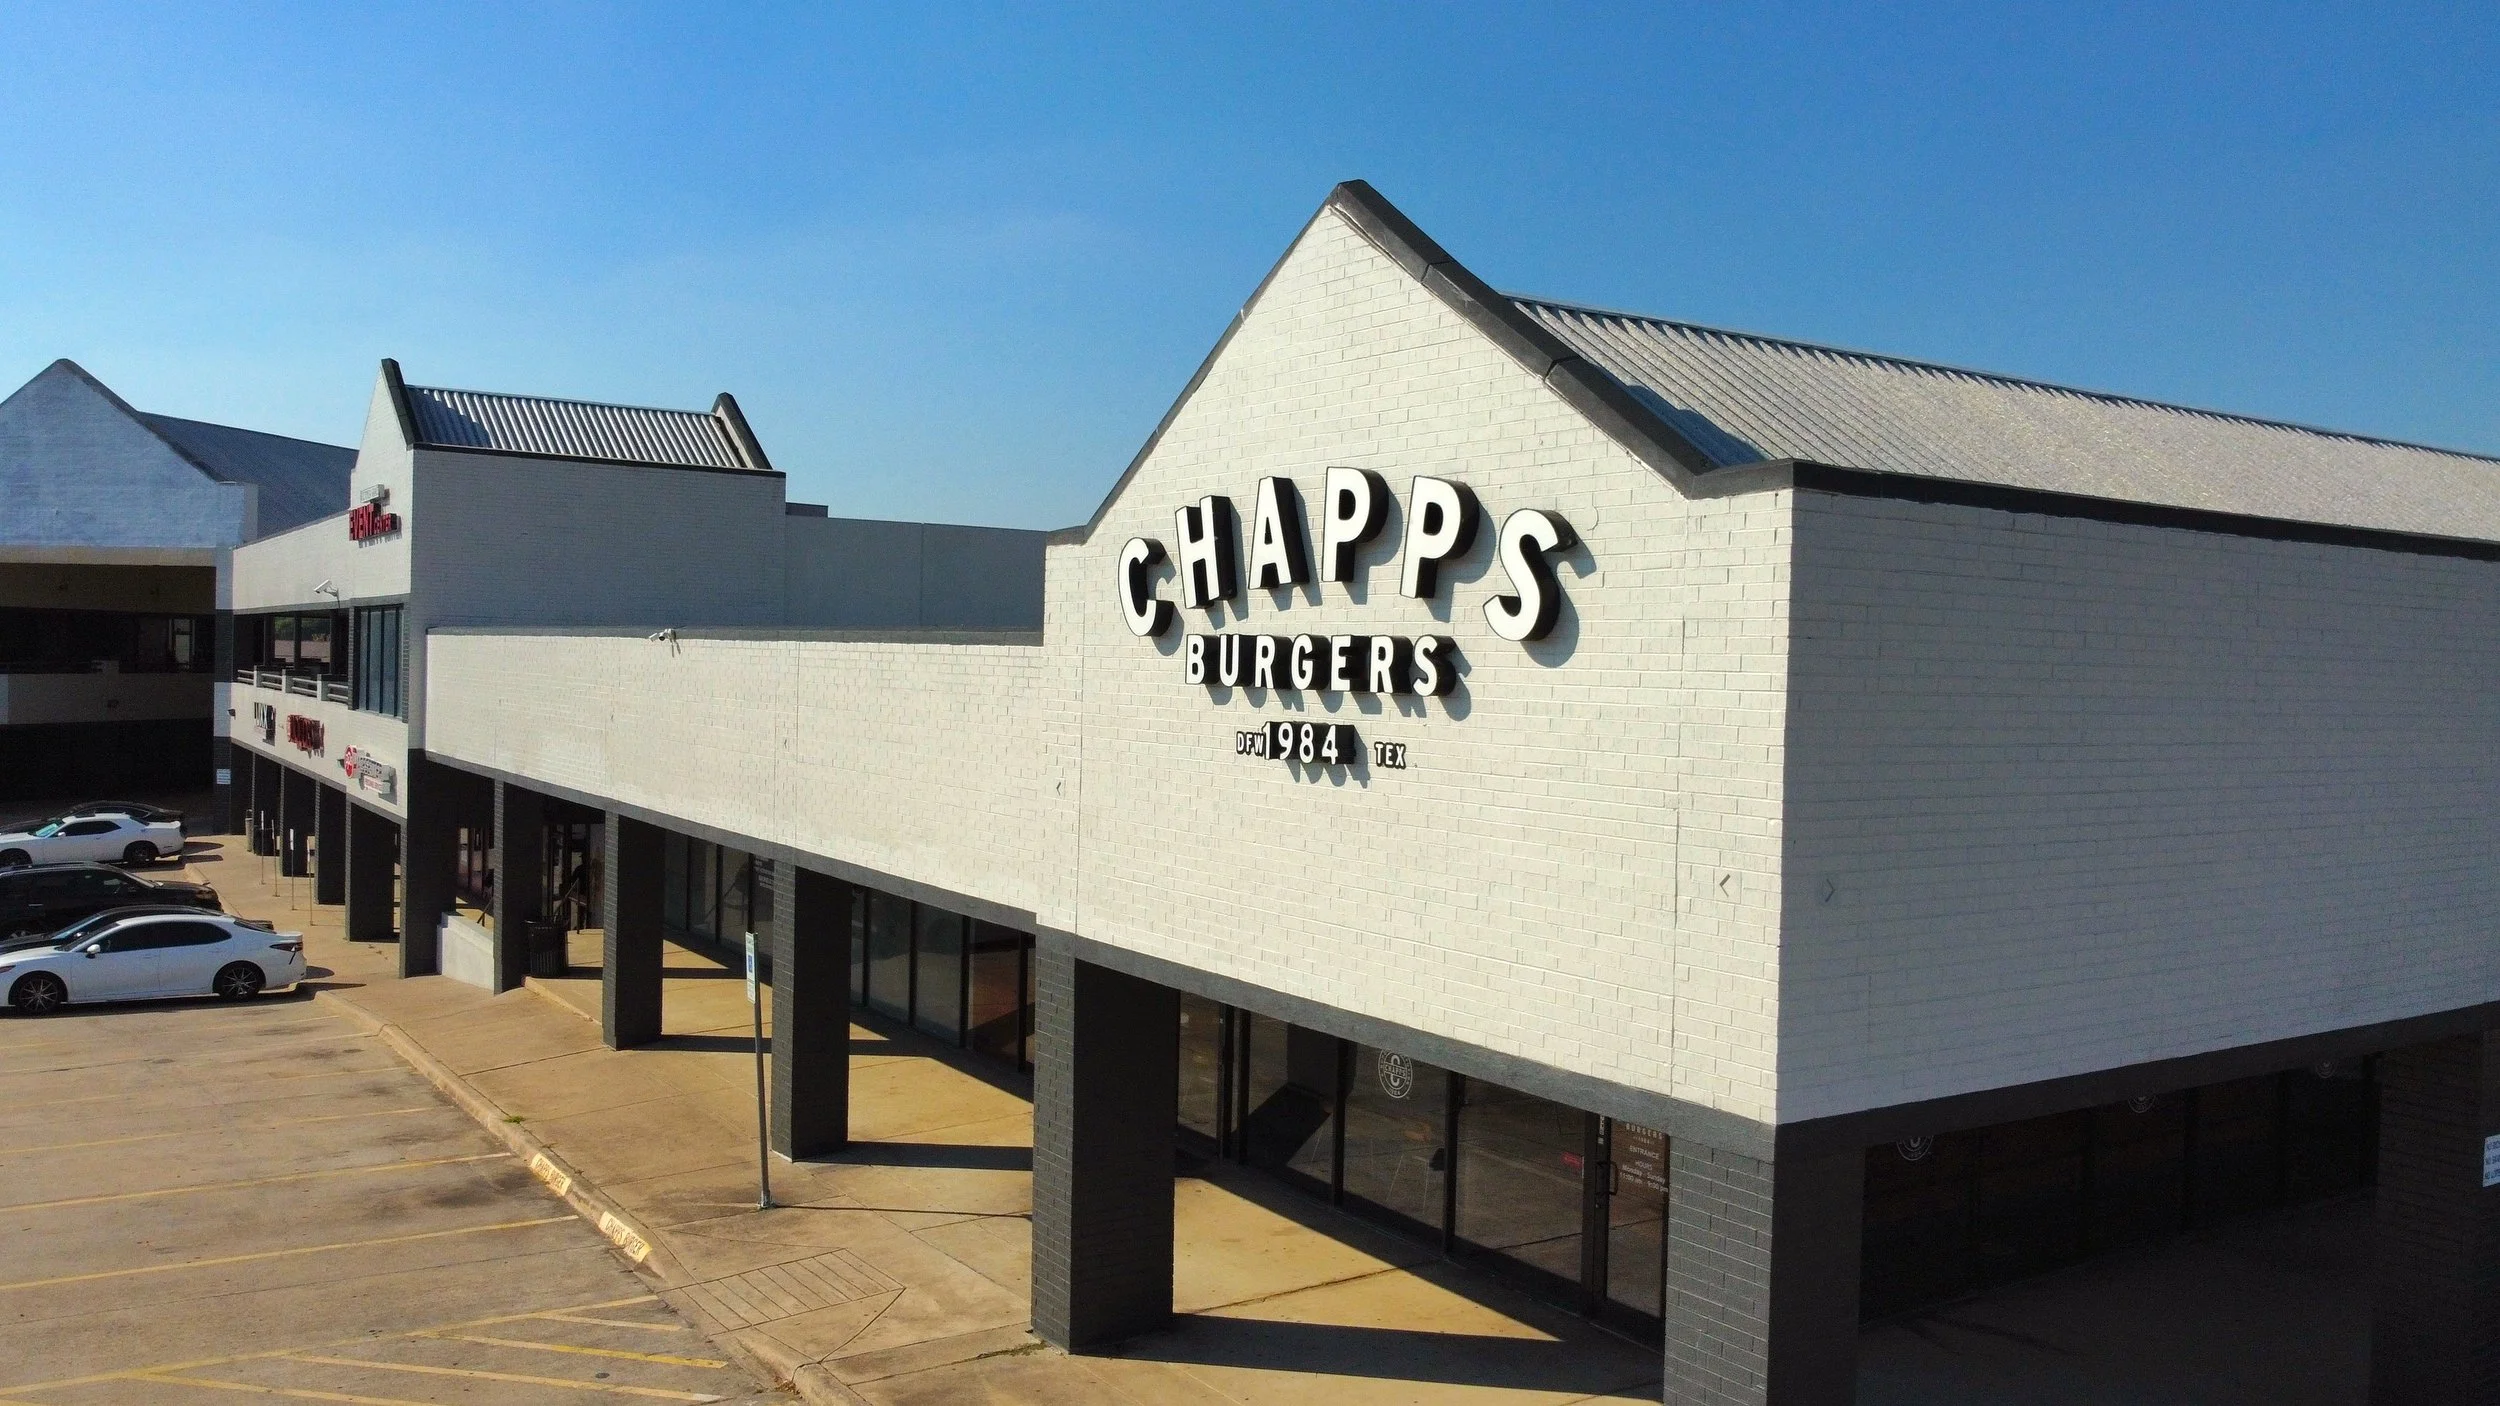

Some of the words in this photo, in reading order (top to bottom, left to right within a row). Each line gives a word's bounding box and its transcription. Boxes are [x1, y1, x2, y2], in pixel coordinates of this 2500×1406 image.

[1118, 466, 1572, 641] CHAPPS
[1185, 634, 1450, 696] BURGERS
[1237, 732, 1264, 755] DFW
[1263, 722, 1339, 765] 1984
[1376, 742, 1406, 768] TEX
[1626, 1123, 1662, 1140] BURGERS
[1630, 1145, 1660, 1160] ENTRANCE
[1622, 1165, 1642, 1176] Monday
[1647, 1172, 1665, 1184] Sunday
